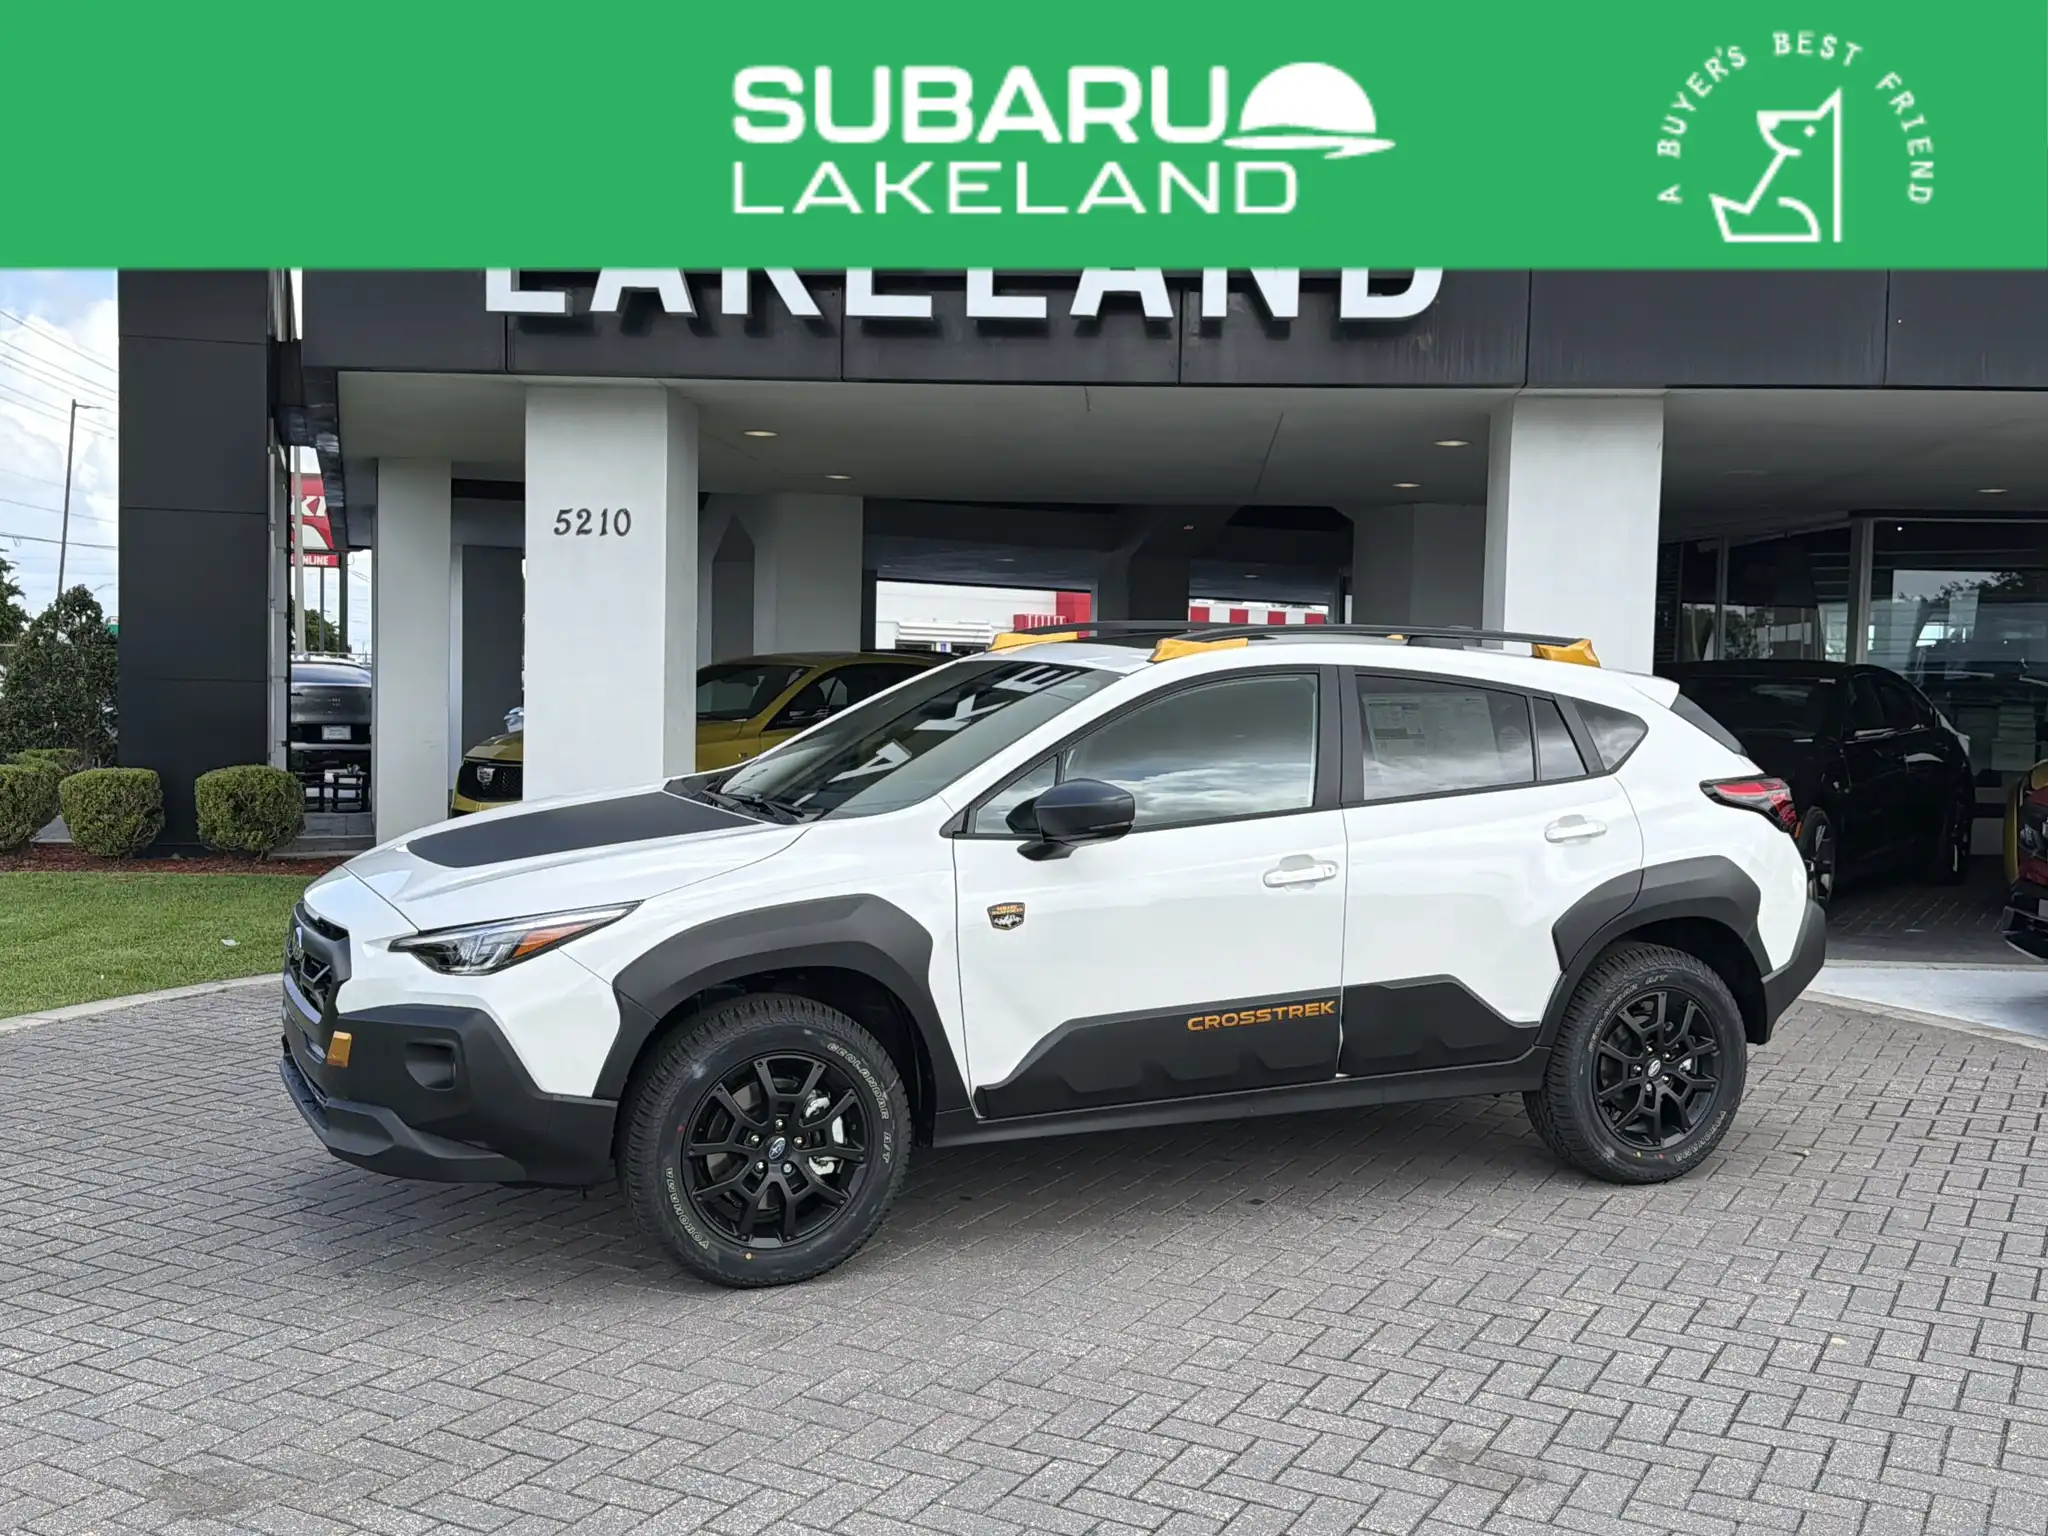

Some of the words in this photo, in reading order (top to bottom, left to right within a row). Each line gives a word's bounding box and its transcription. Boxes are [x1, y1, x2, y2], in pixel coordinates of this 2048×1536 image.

[554, 508, 631, 537] 5210
[302, 555, 329, 566] NLINE
[1187, 1001, 1335, 1032] CROSSTREK
